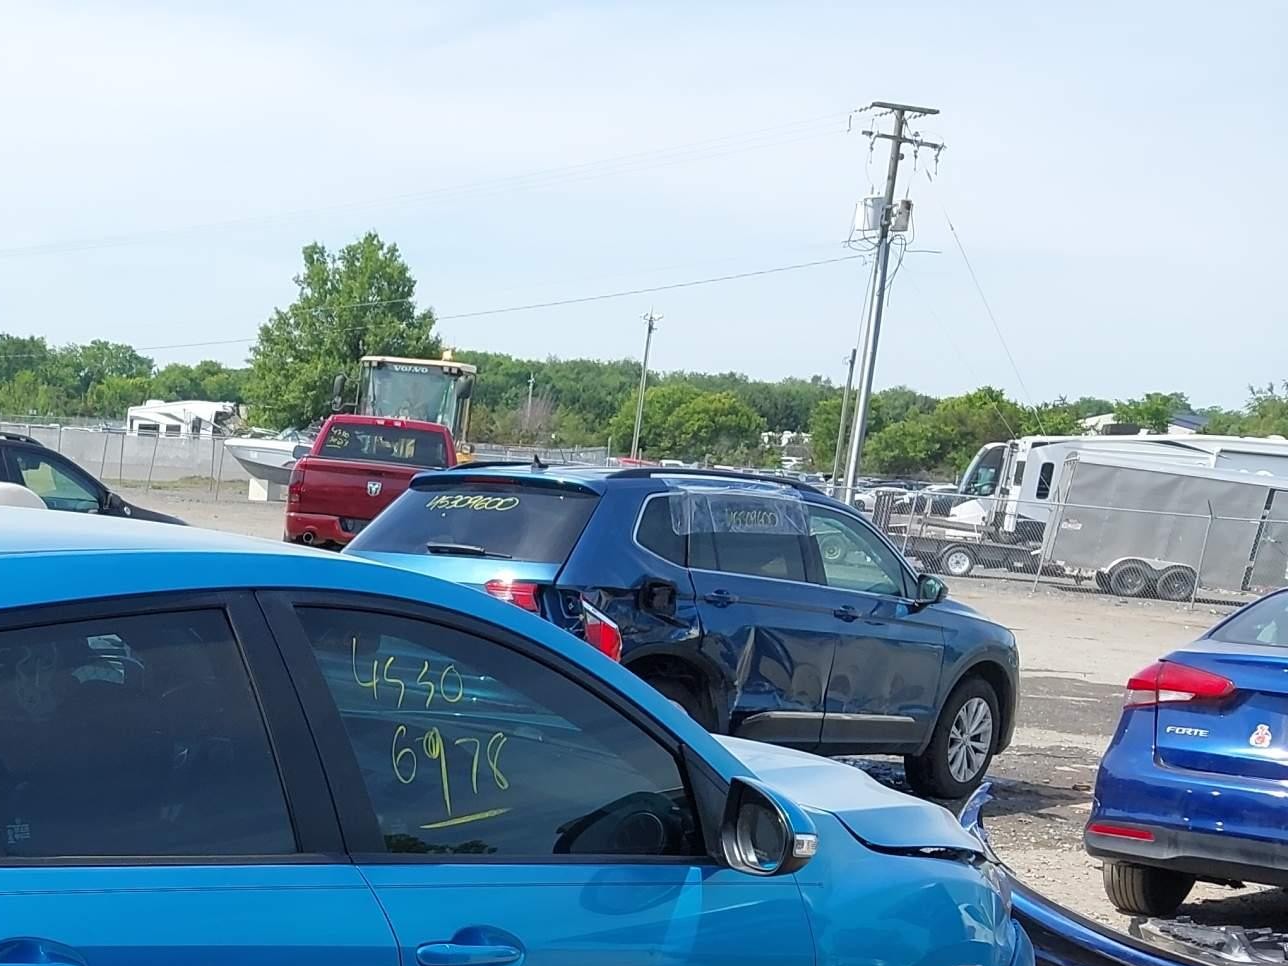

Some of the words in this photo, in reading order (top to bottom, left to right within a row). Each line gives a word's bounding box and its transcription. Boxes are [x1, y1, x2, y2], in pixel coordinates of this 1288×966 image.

[392, 363, 429, 374] VOLVO
[1165, 725, 1210, 738] FORTE
[391, 724, 510, 817] 6978
